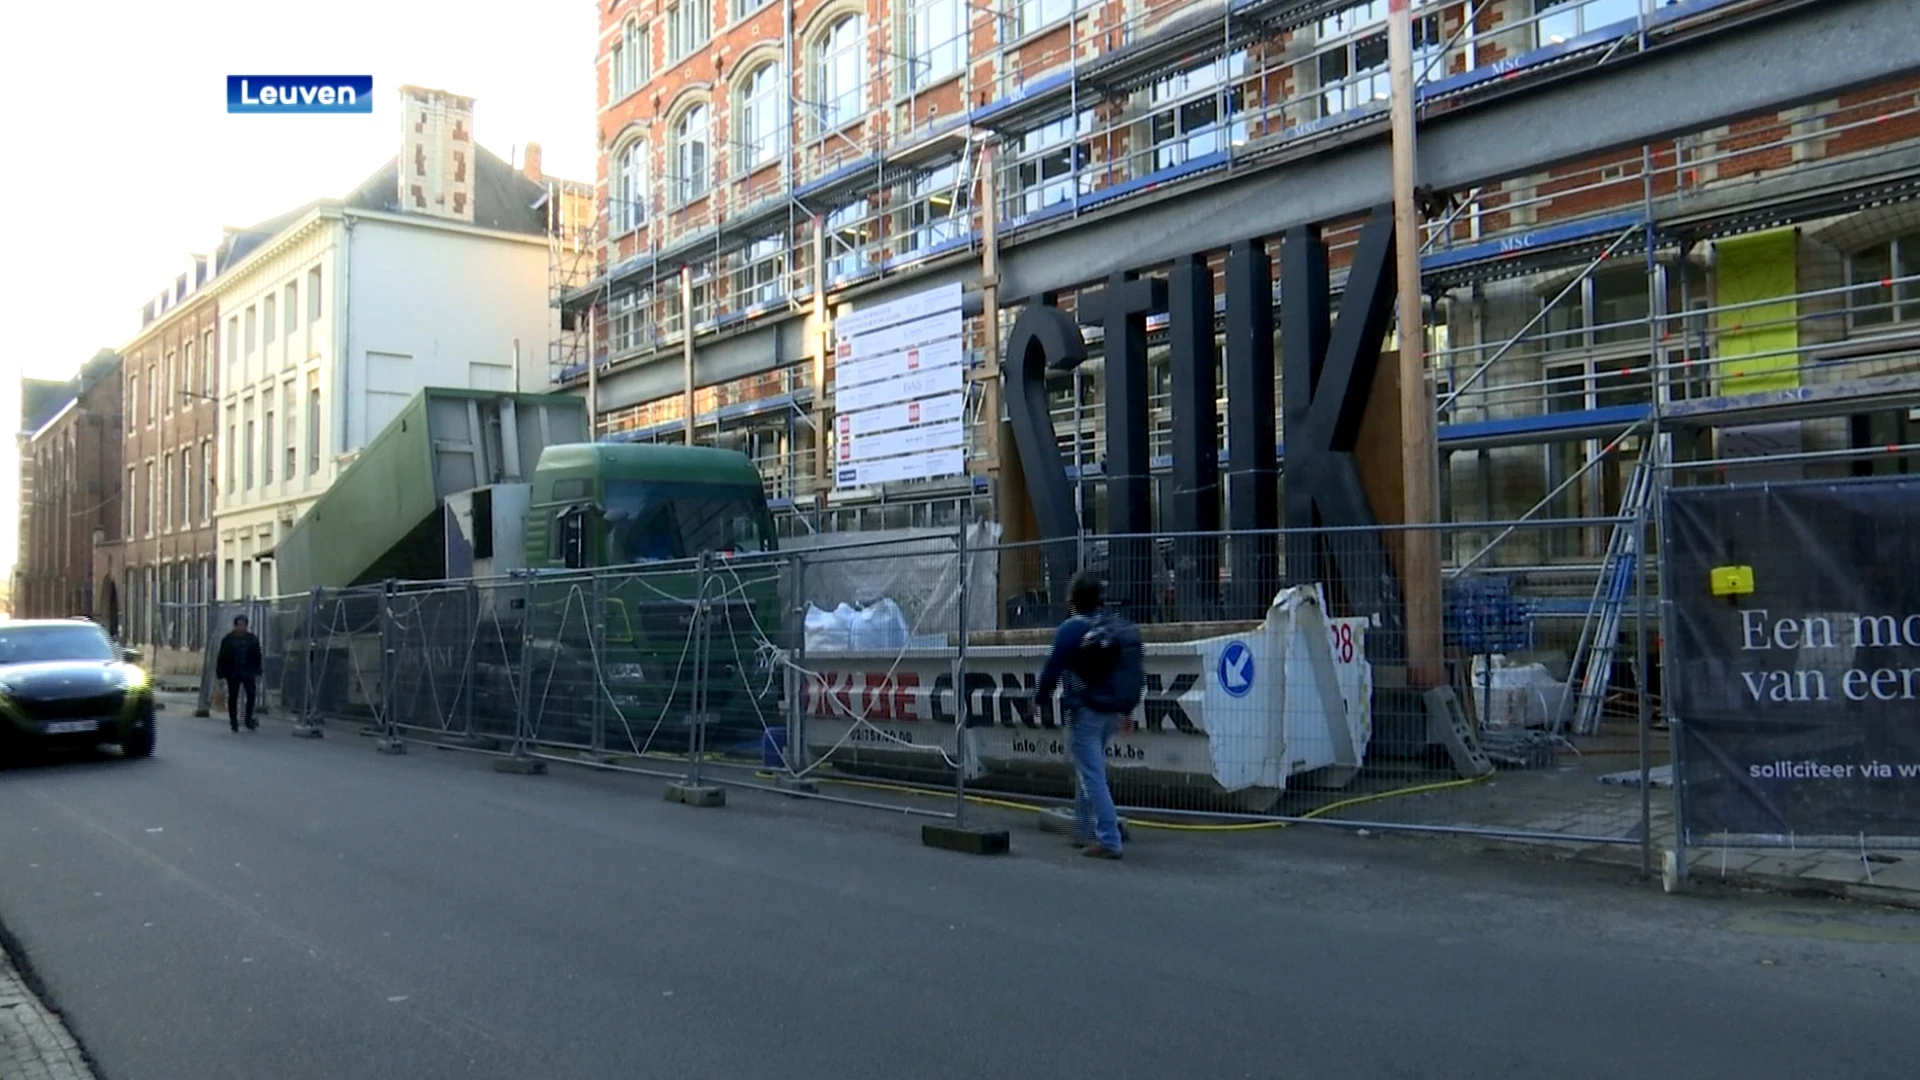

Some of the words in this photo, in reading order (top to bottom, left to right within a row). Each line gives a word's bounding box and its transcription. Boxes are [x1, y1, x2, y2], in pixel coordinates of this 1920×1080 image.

[1491, 55, 1526, 75] MSC
[1500, 232, 1535, 252] MSC
[1740, 609, 1834, 650] Een
[1742, 669, 1829, 702] van
[1749, 761, 1855, 778] solliciteer
[1862, 761, 1893, 778] via
